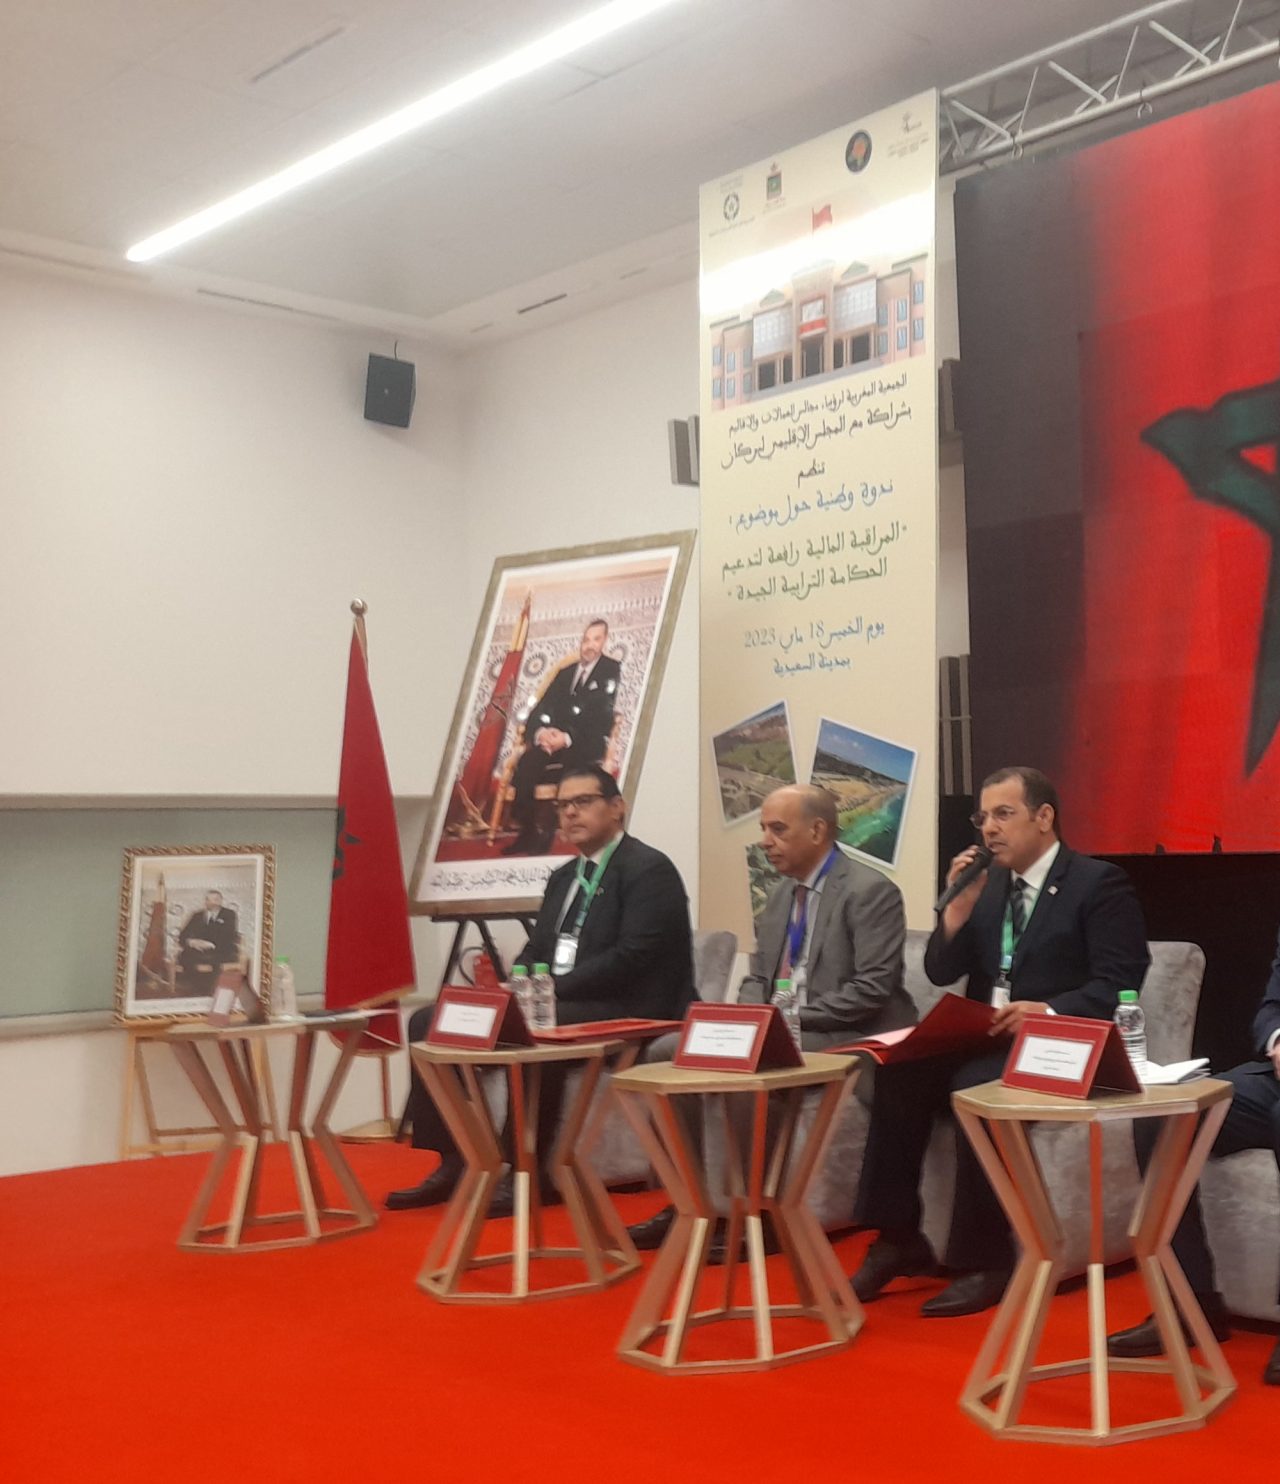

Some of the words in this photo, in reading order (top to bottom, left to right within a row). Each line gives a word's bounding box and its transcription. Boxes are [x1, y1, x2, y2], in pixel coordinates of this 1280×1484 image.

[848, 419, 864, 437] مع
[866, 400, 912, 430] بشراكة
[805, 414, 846, 449] المجلس
[797, 457, 825, 488] تنظم
[816, 483, 854, 511] وطنية
[861, 479, 893, 506] ندوة
[736, 504, 779, 535] موضوع
[776, 494, 811, 526] حول
[768, 541, 799, 566] رافعة
[806, 531, 845, 560] المالية
[722, 547, 763, 581] لتدعيم
[830, 556, 888, 585] الحكامة
[737, 576, 776, 602] الجيدة
[781, 568, 825, 600] الترابية
[744, 627, 776, 648] 2023
[780, 626, 803, 654] ماي
[810, 620, 825, 639] 18
[819, 615, 863, 649] الخميس
[867, 622, 885, 645] يوم
[773, 652, 816, 678] السعيدية
[818, 652, 851, 672] بمدينة
